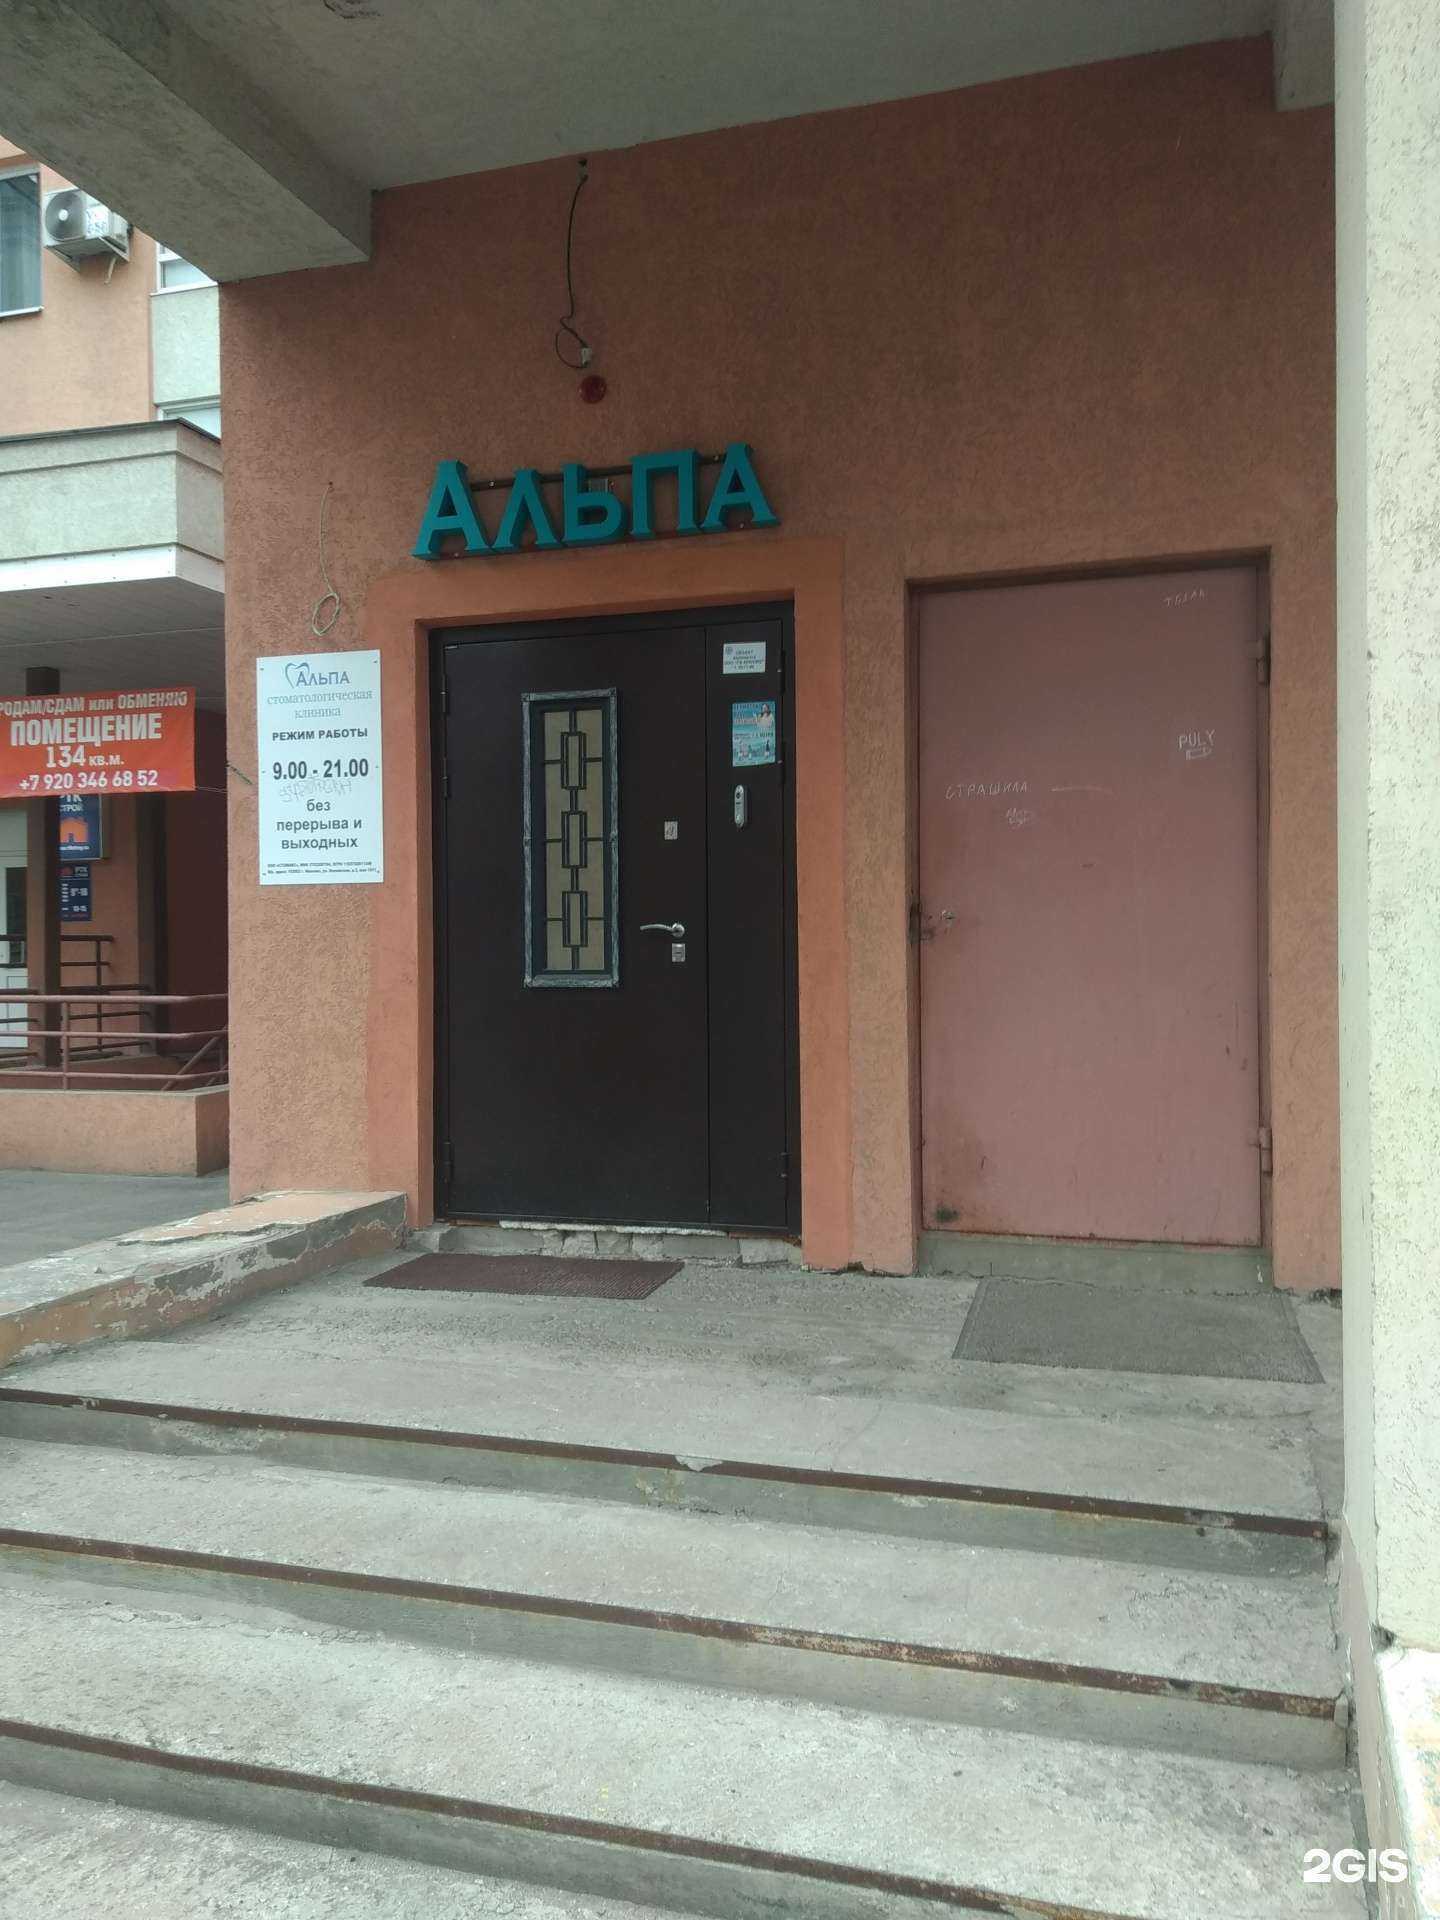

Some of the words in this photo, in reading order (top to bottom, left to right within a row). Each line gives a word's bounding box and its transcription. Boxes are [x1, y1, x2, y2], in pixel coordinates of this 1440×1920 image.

[411, 442, 781, 561] АЛЬПА
[118, 691, 188, 709] ОБМЕНЯЮ
[11, 713, 162, 747] ПОМЕЩЕНИЕ
[272, 731, 315, 741] РЕЖИМ
[319, 728, 368, 739] РАБОТЫ
[47, 745, 86, 768] 134
[273, 761, 308, 780] 9.00
[323, 758, 369, 778] 21.00
[20, 775, 39, 791] +7
[44, 773, 73, 789] 920
[78, 772, 108, 788] 346
[112, 771, 133, 787] 68
[137, 770, 158, 786] 52
[306, 799, 331, 812] без
[276, 819, 349, 833] перерыва
[354, 819, 362, 829] и
[281, 838, 359, 850] выходных
